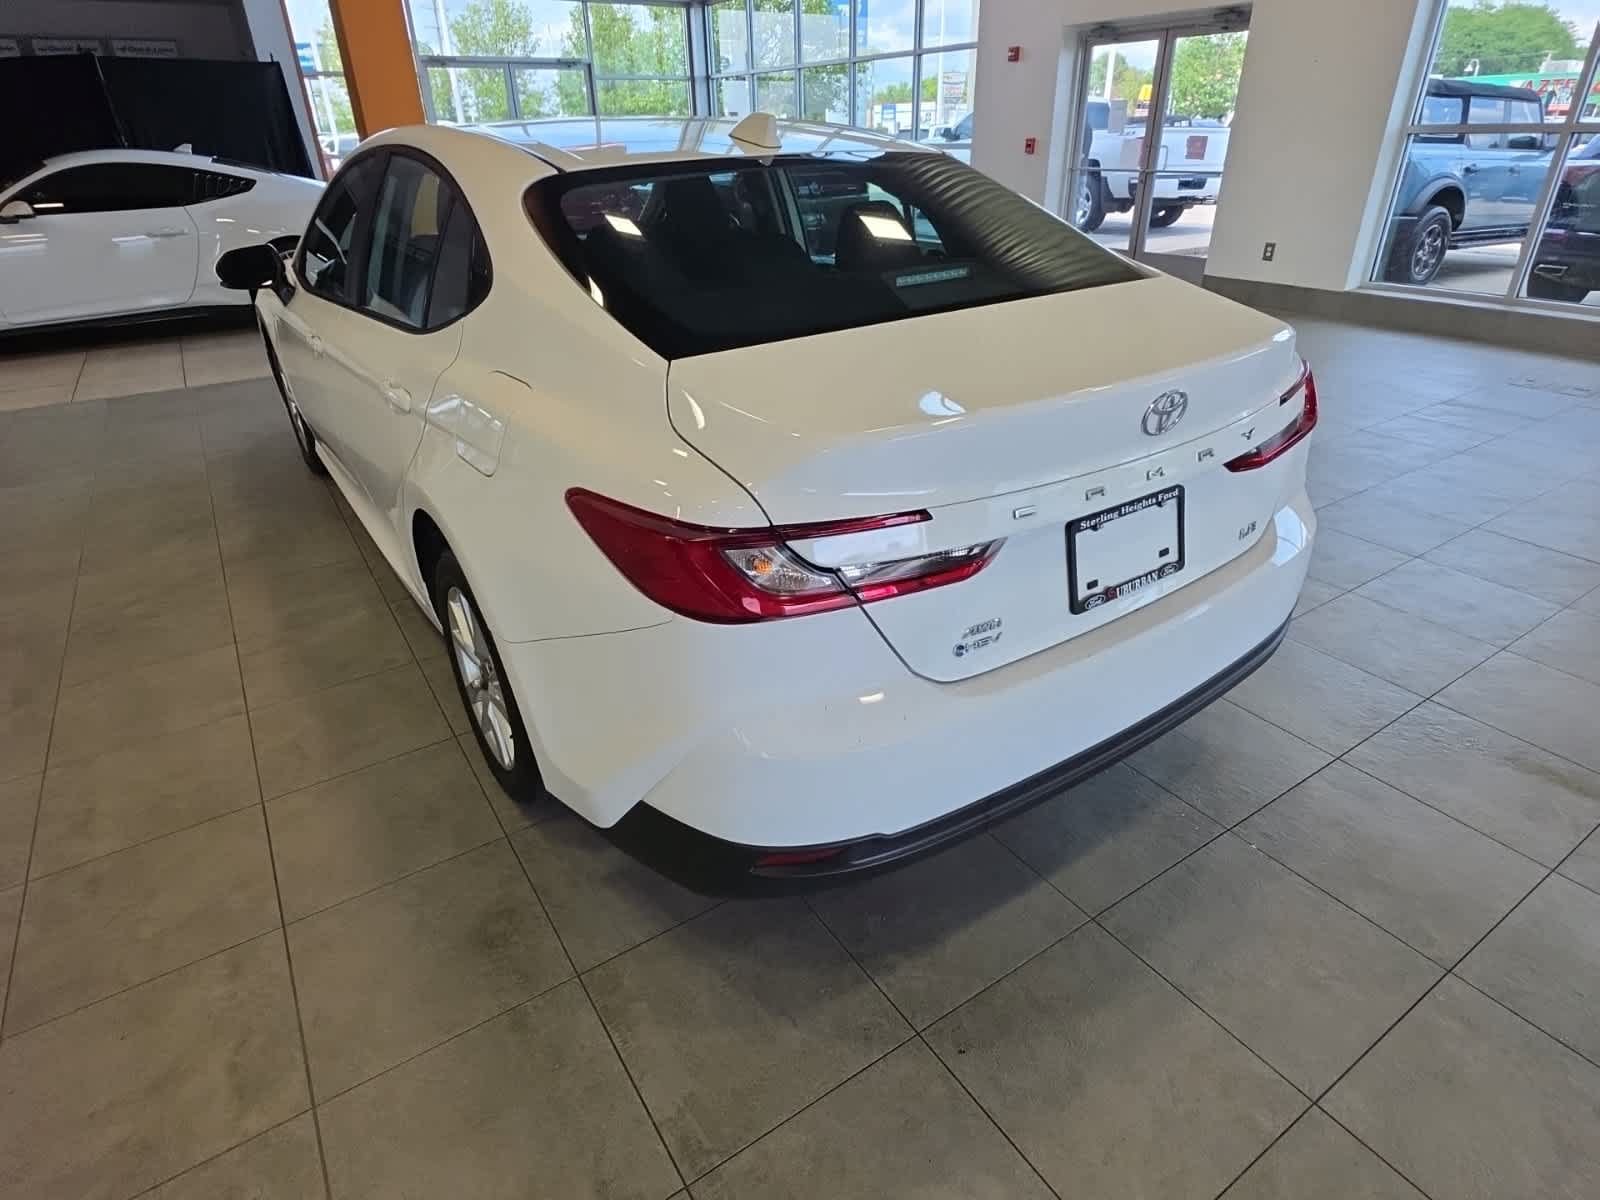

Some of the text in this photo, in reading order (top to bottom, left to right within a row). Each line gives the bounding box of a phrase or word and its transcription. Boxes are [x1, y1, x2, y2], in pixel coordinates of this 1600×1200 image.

[1080, 488, 1179, 530] Sterling Heights Ford
